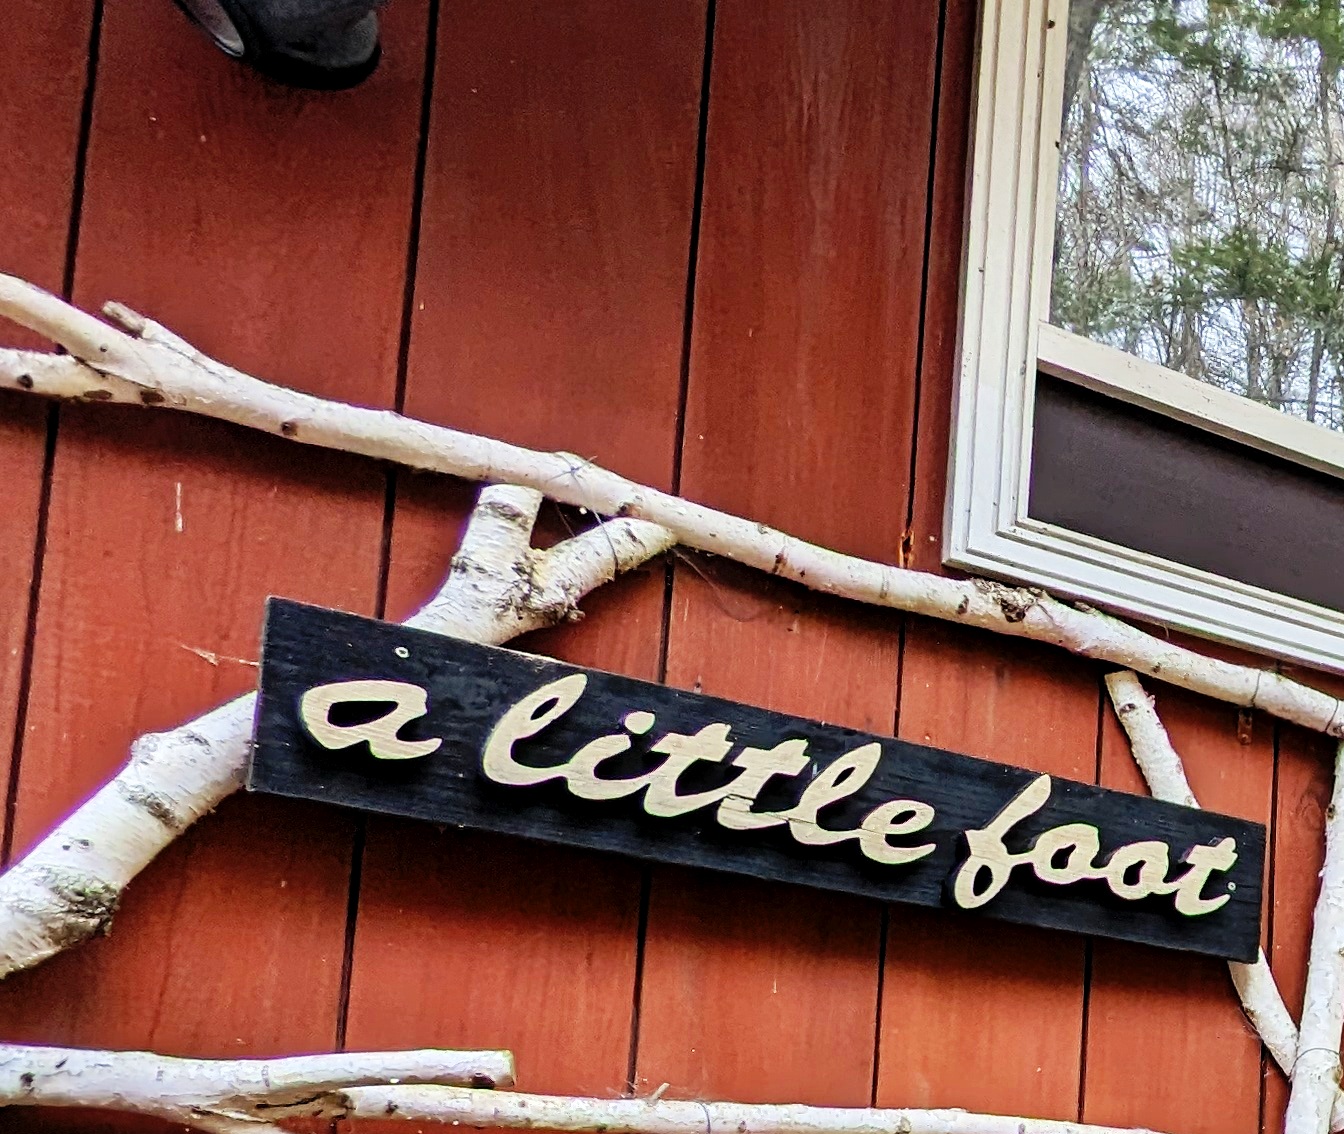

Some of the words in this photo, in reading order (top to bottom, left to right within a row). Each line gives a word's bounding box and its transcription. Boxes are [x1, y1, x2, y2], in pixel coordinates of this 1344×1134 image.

[300, 678, 441, 760] a
[483, 673, 937, 866] little
[953, 774, 1238, 916] foot
